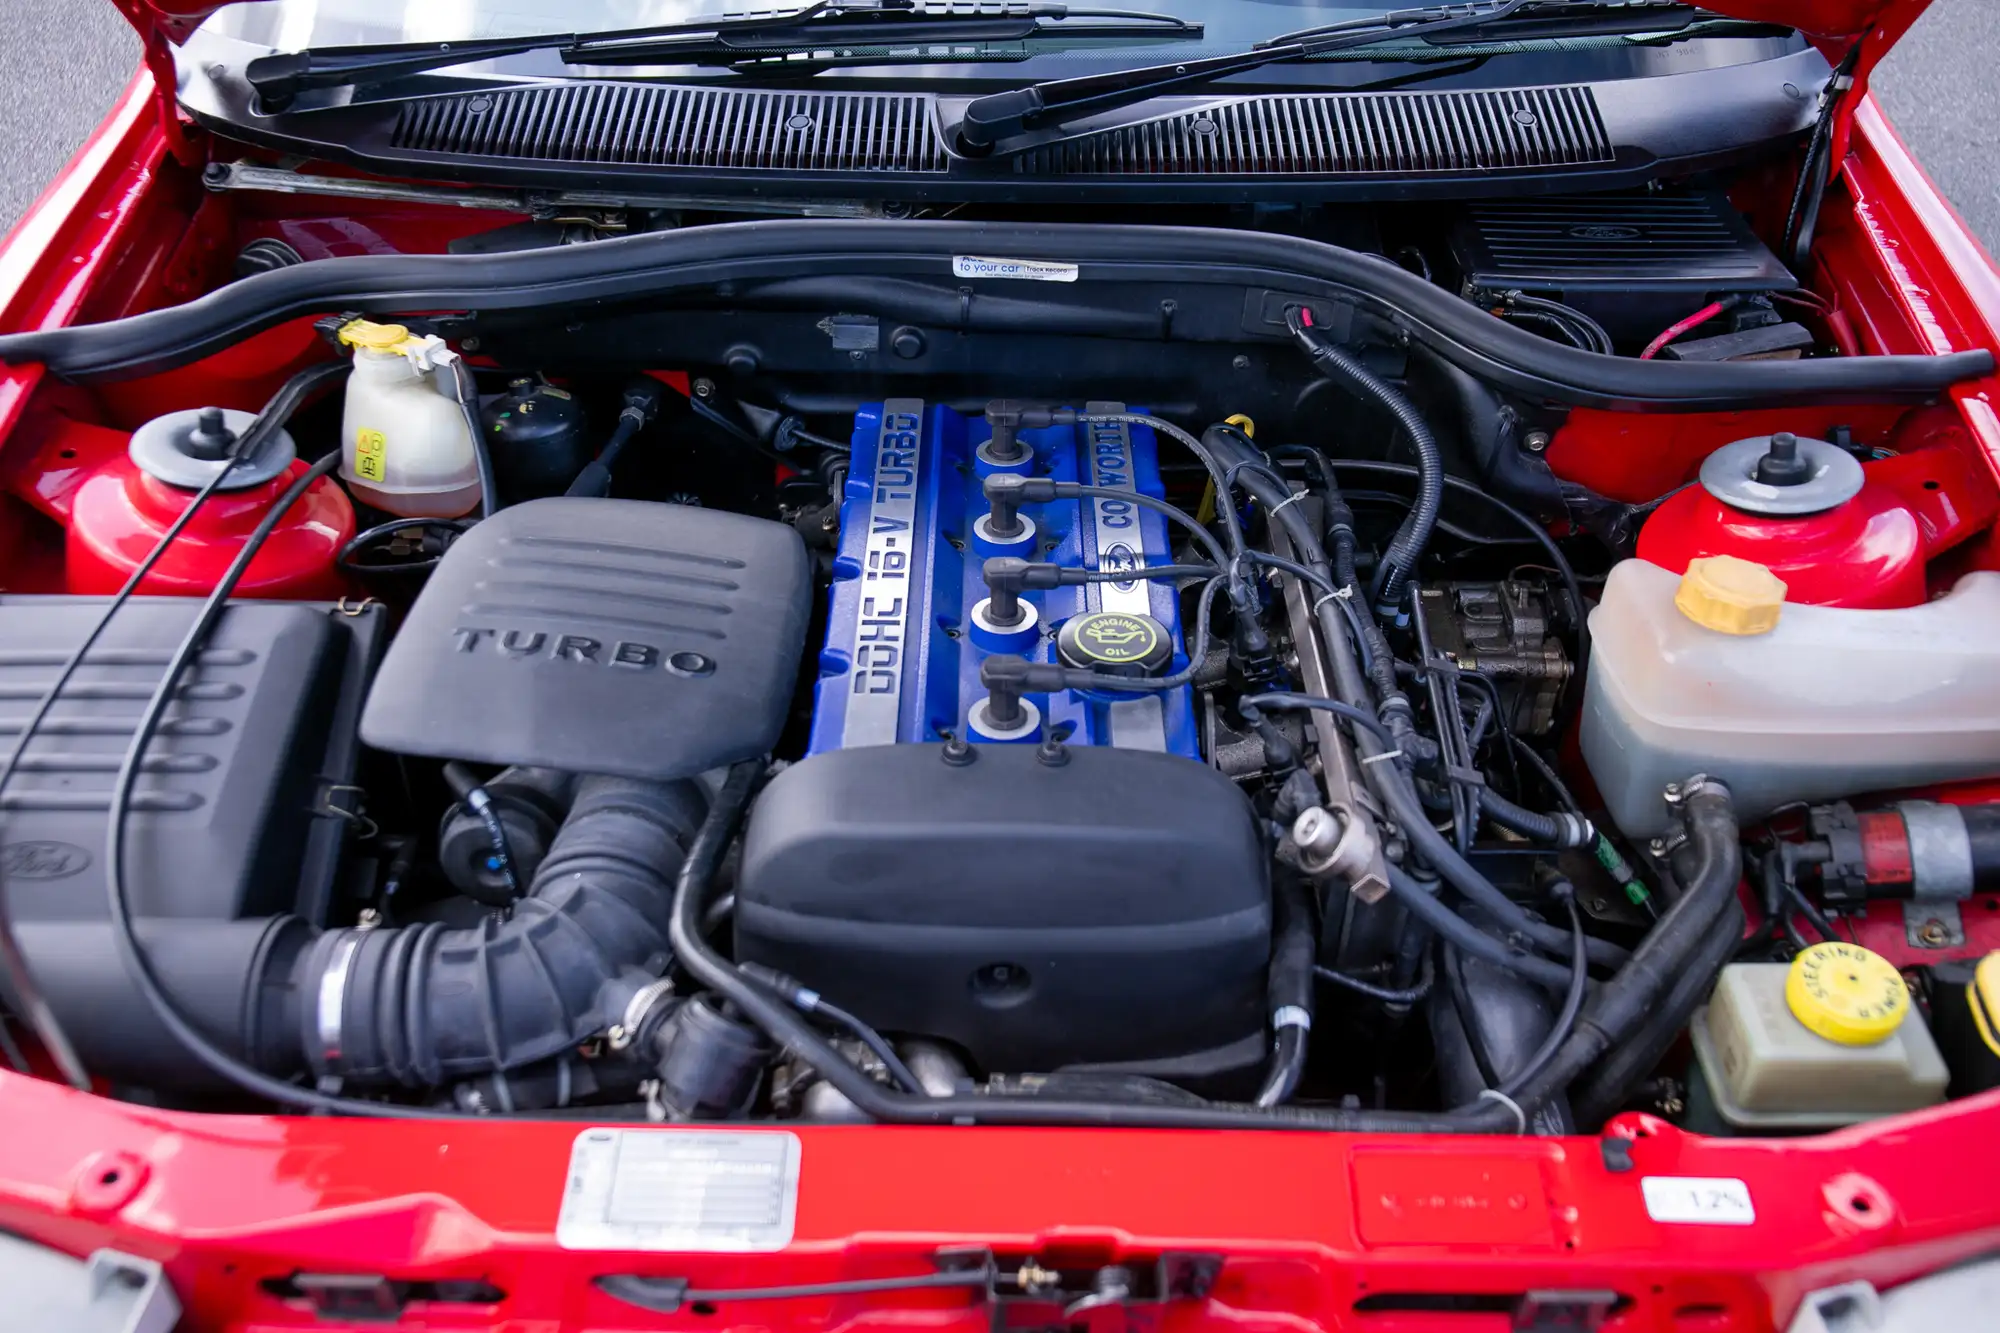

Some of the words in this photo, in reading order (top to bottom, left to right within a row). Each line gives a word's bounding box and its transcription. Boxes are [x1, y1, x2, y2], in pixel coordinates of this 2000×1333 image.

[960, 263, 970, 271] to
[974, 264, 997, 273] your
[1001, 265, 1020, 273] car
[876, 413, 919, 503] TURBO
[1095, 419, 1133, 529] COWORTH
[866, 516, 910, 581] 16-V
[854, 597, 903, 694] DOHC
[1090, 618, 1142, 632] ENGINE
[452, 626, 718, 678] TURBO
[1104, 647, 1130, 656] OIL
[1803, 946, 1867, 998] STEERING
